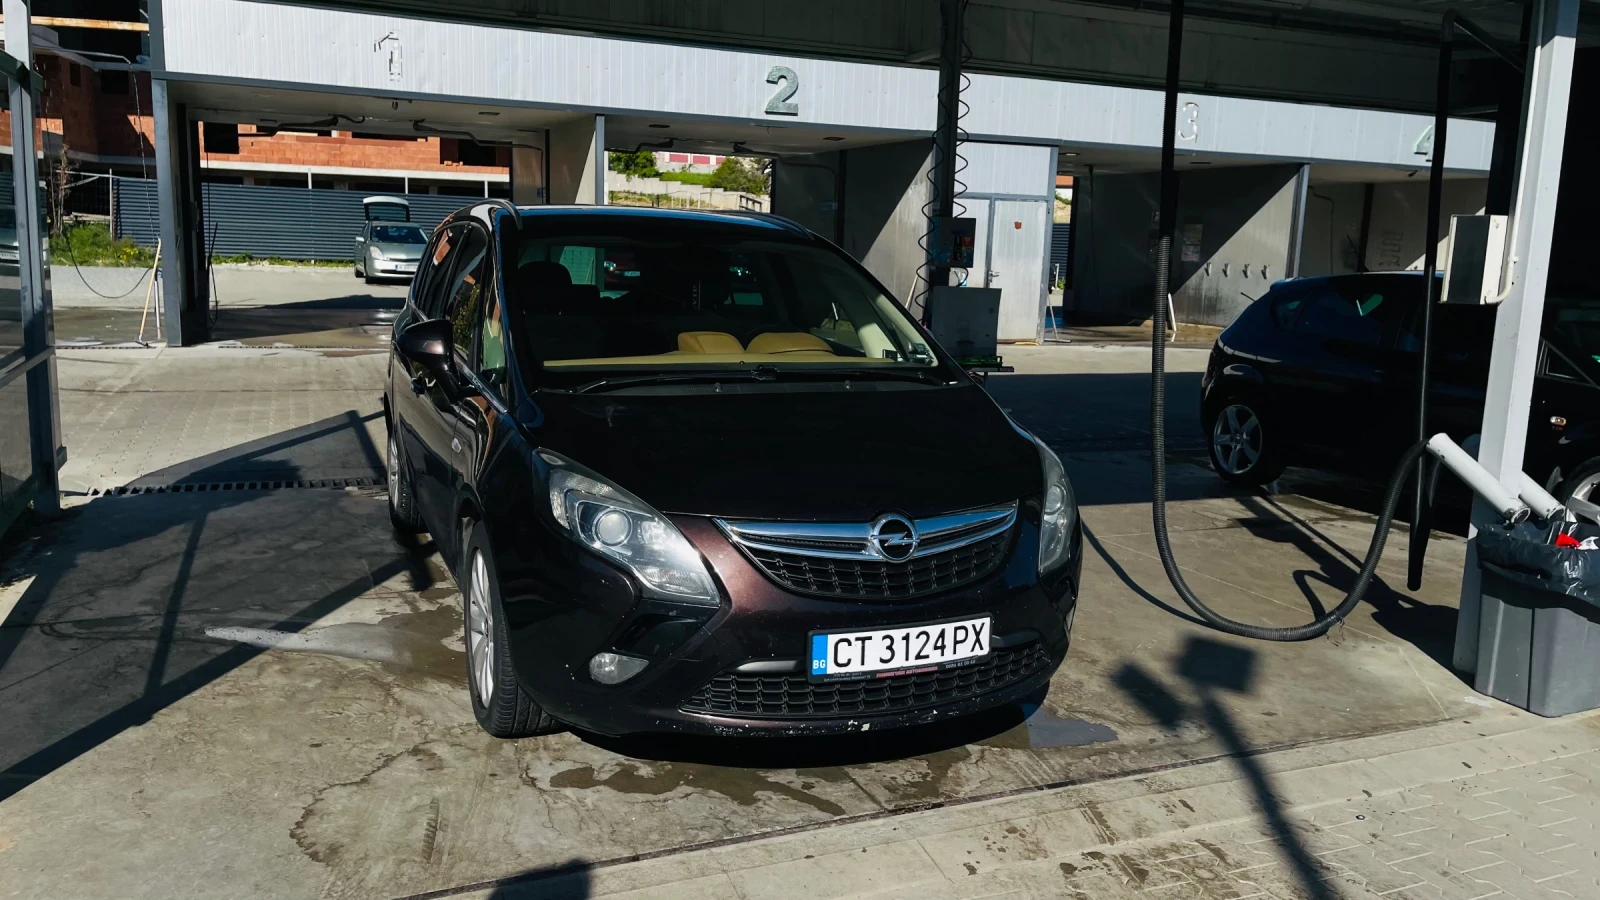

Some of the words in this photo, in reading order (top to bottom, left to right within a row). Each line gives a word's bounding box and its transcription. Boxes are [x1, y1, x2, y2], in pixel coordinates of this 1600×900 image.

[373, 29, 403, 82] 1
[764, 66, 799, 116] 2
[1178, 102, 1199, 143] 3
[812, 659, 826, 669] BG
[833, 636, 873, 668] CT
[879, 628, 946, 664] 3124
[953, 622, 985, 655] PX
